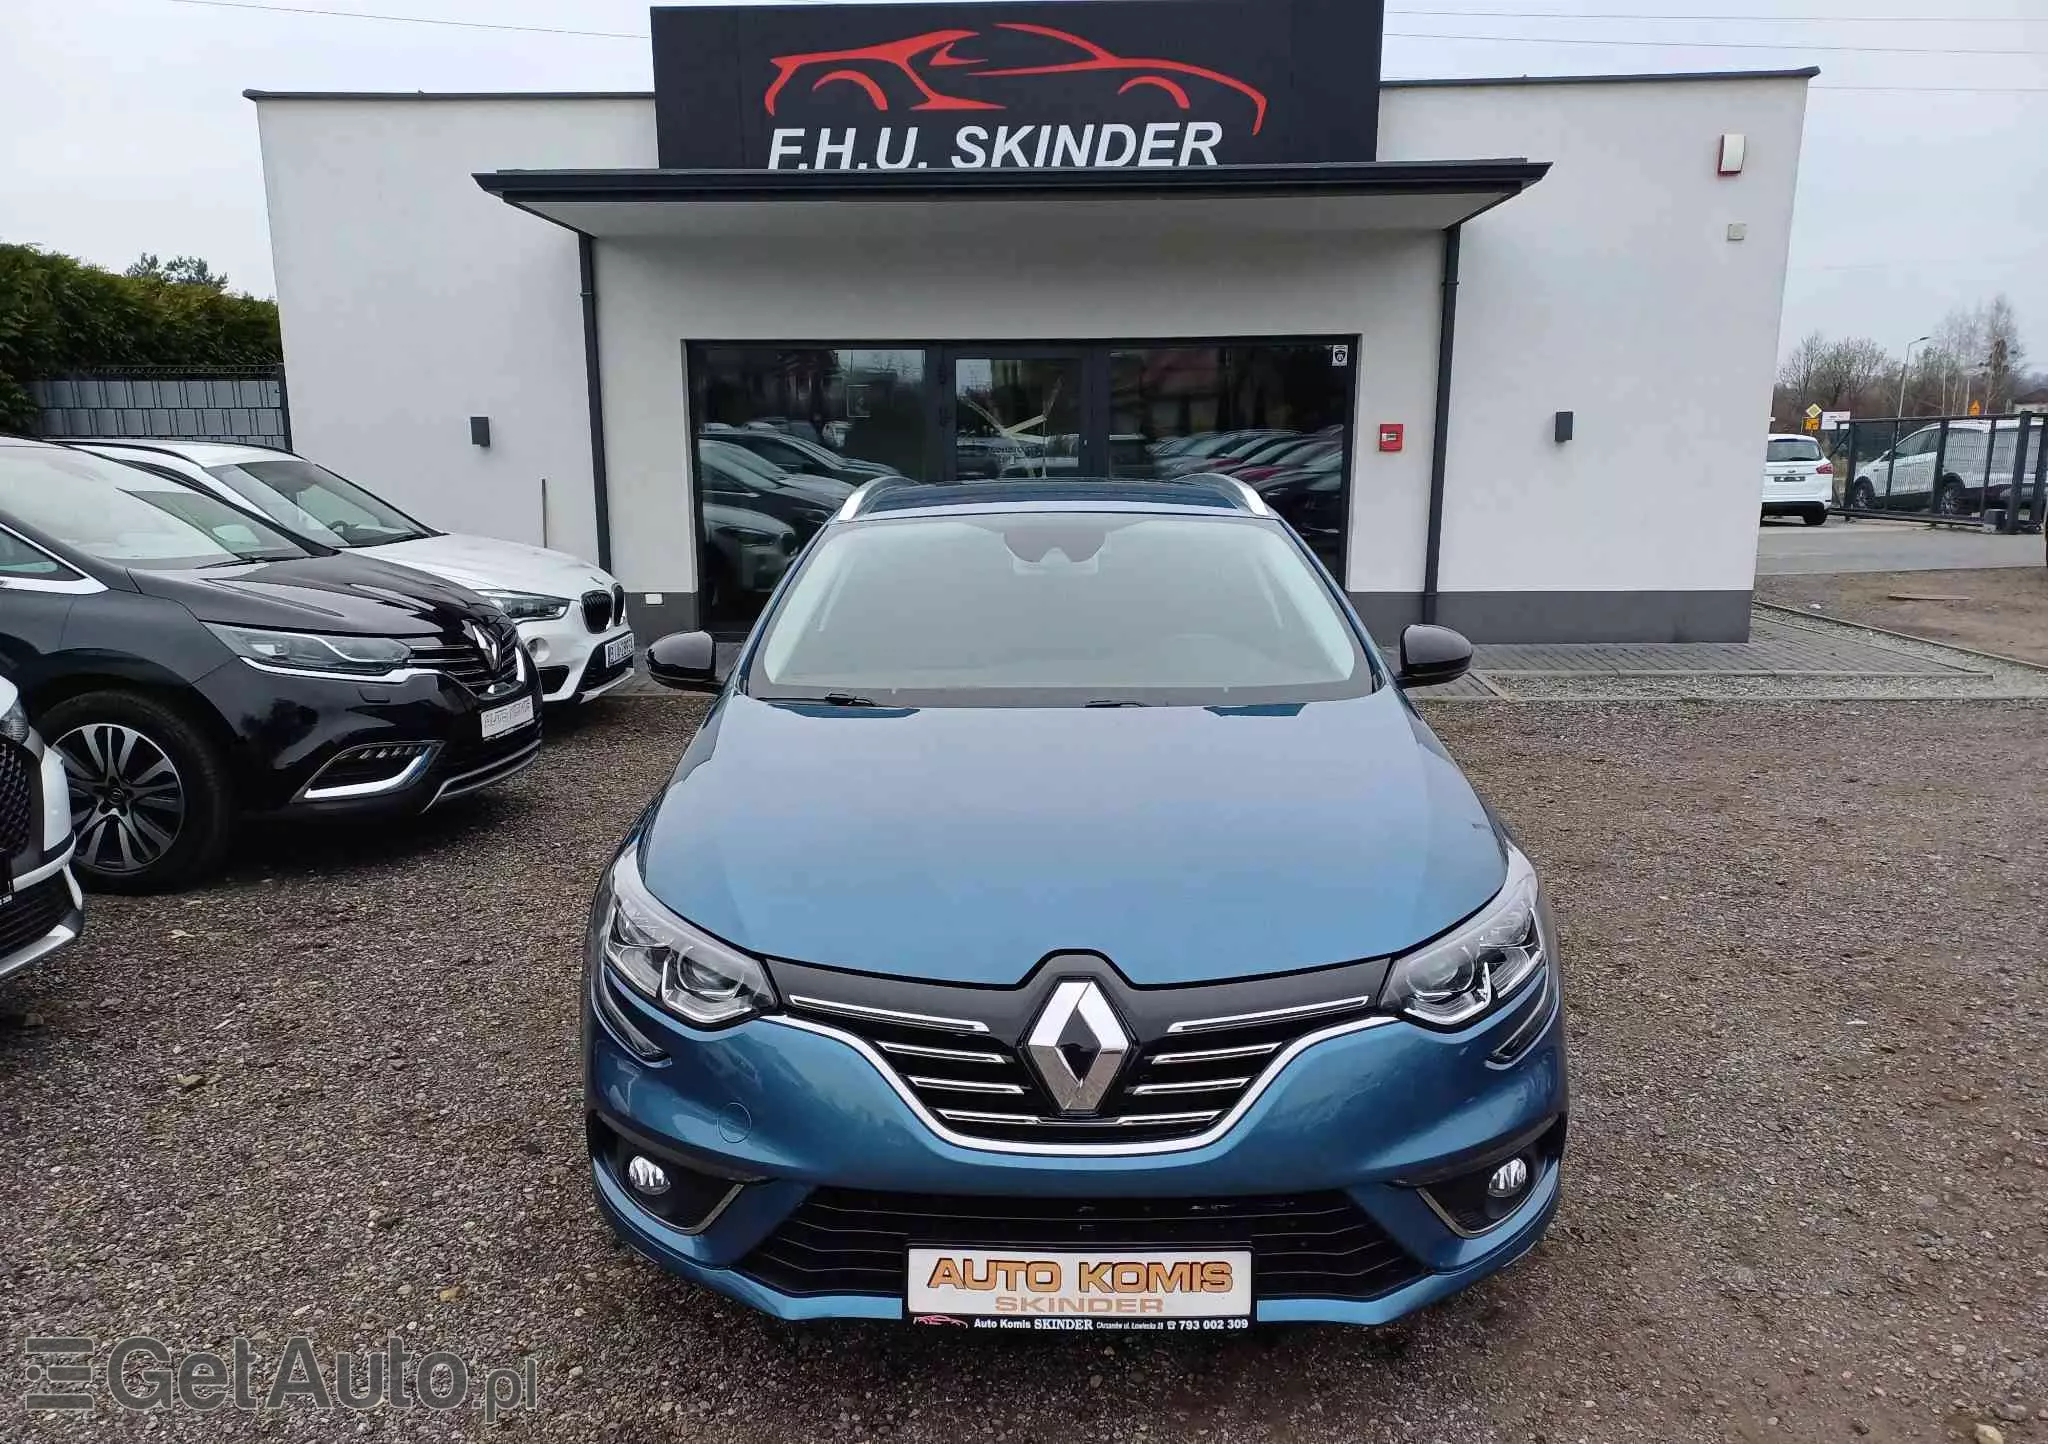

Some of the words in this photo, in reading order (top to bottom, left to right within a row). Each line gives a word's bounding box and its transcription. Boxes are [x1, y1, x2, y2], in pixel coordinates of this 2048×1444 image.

[768, 126, 928, 170] F.H.U.
[951, 121, 1223, 168] SKINDER
[927, 1257, 1062, 1291] AUTO
[1078, 1261, 1233, 1293] KOMIS
[995, 1297, 1164, 1313] SKINDER
[973, 1318, 998, 1329] Auto
[1000, 1319, 1031, 1329] Komis
[1034, 1318, 1094, 1330] SKINDER
[1178, 1319, 1200, 1330] 793
[1202, 1319, 1224, 1330] 002
[1227, 1318, 1249, 1329] 309
